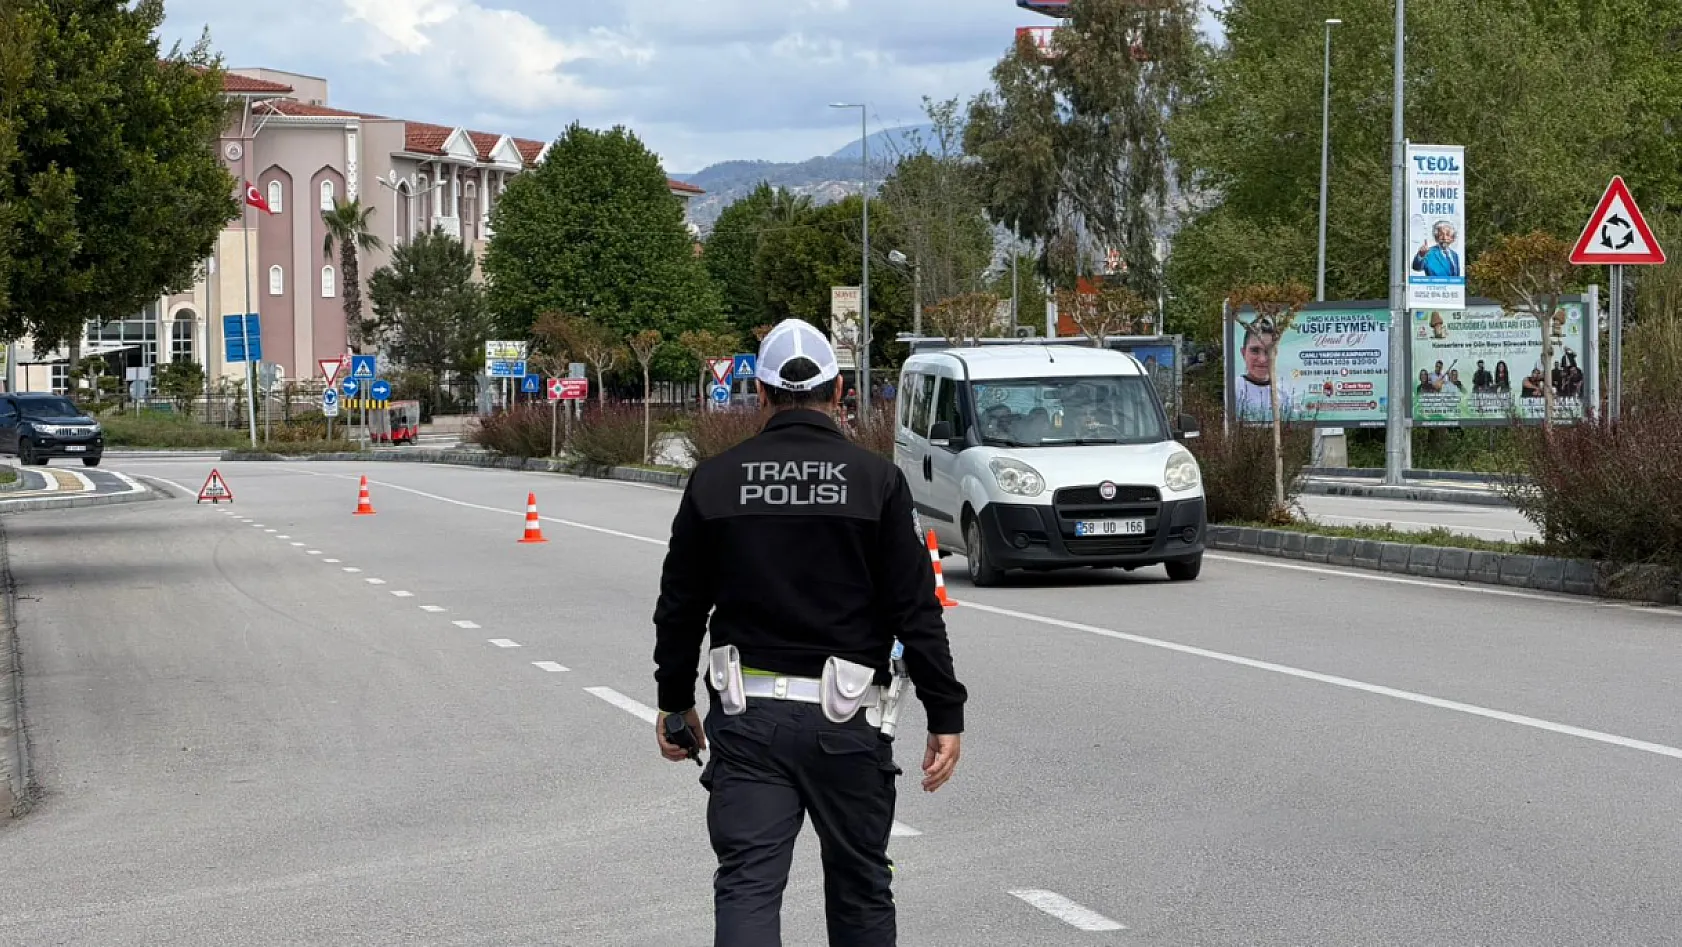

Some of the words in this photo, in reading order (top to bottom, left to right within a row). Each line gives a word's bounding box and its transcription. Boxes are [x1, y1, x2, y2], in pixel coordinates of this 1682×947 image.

[1413, 155, 1459, 171] TEOL
[1416, 184, 1459, 199] YERİNDE
[1421, 199, 1455, 215] ÖĞREN
[1296, 322, 1332, 334] YUSUF
[1335, 321, 1386, 334] EYMEN'E
[1082, 523, 1095, 534] 58
[1125, 521, 1143, 533] 166
